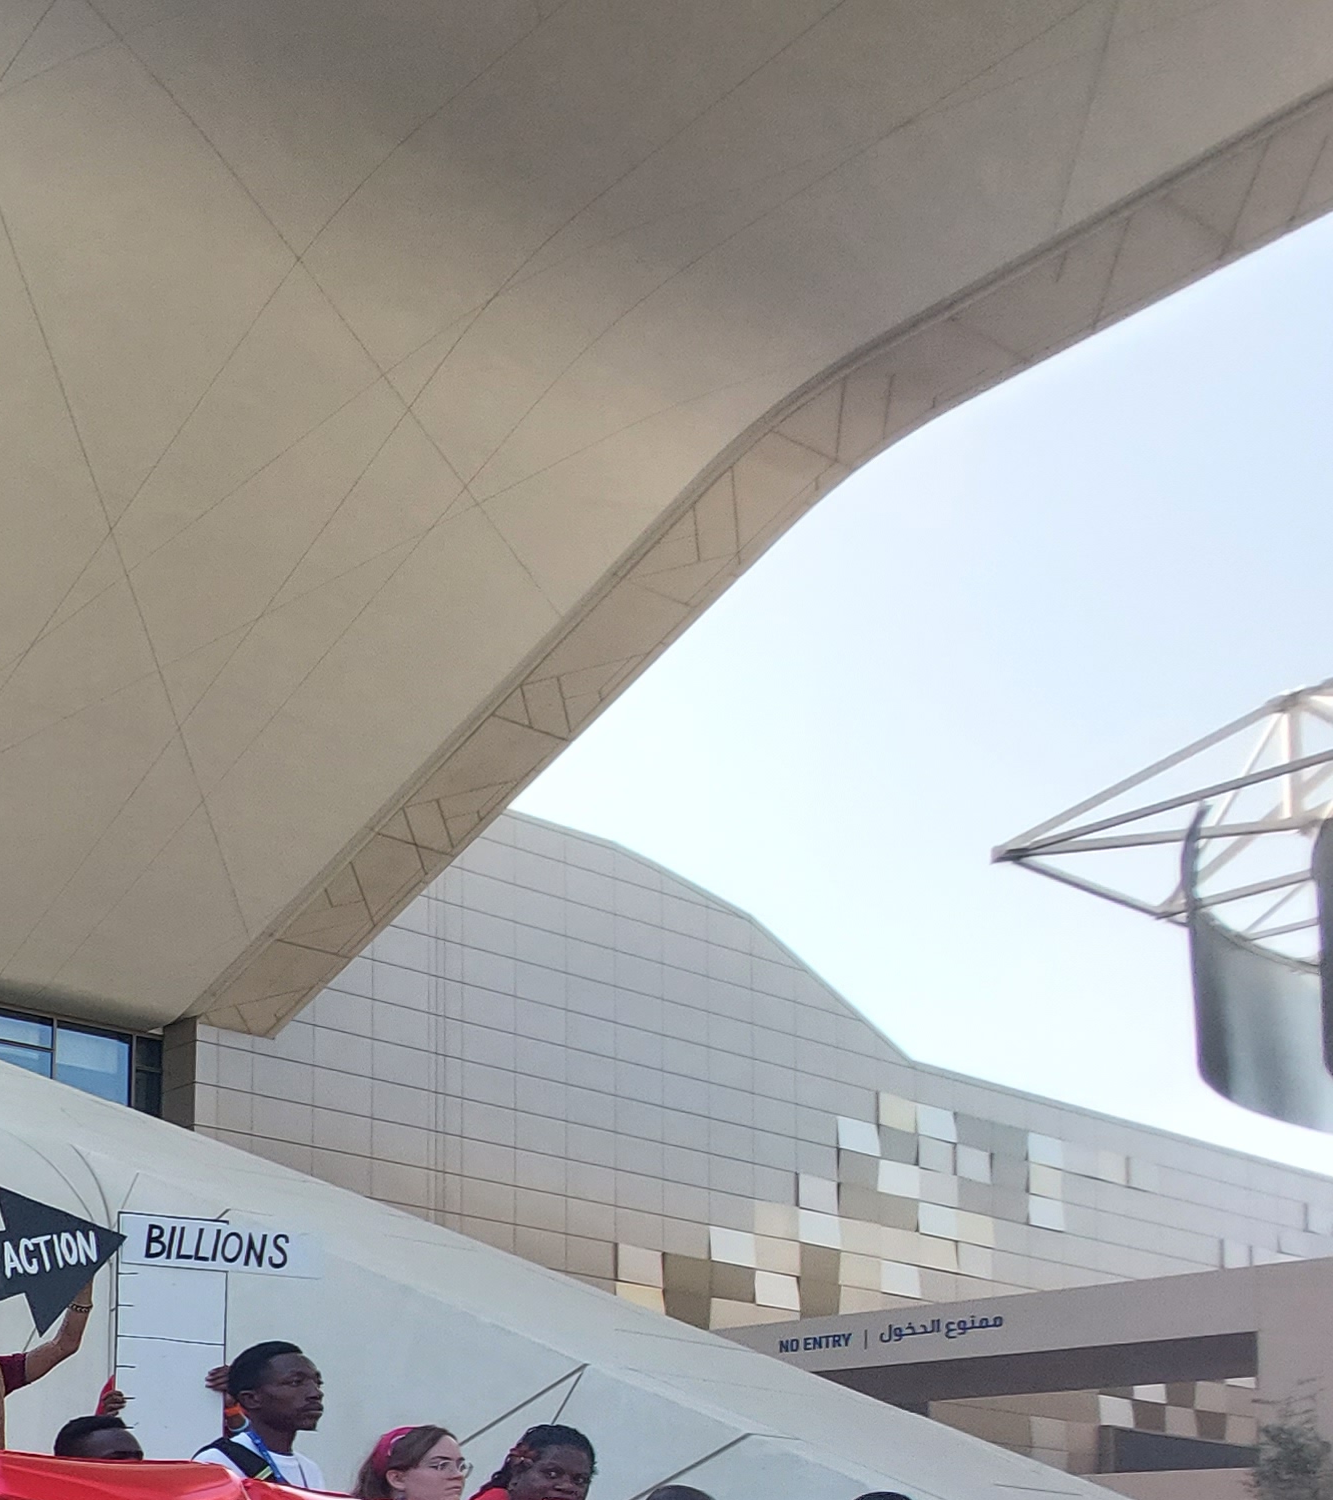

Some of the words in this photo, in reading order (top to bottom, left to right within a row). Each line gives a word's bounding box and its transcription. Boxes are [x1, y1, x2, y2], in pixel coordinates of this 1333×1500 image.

[3, 1229, 99, 1280] ACTION
[144, 1223, 290, 1270] BILLIONS
[879, 1318, 941, 1344] الدخول
[944, 1314, 1004, 1340] ممنوع
[779, 1338, 800, 1353] NO
[803, 1333, 852, 1351] ENTRY
